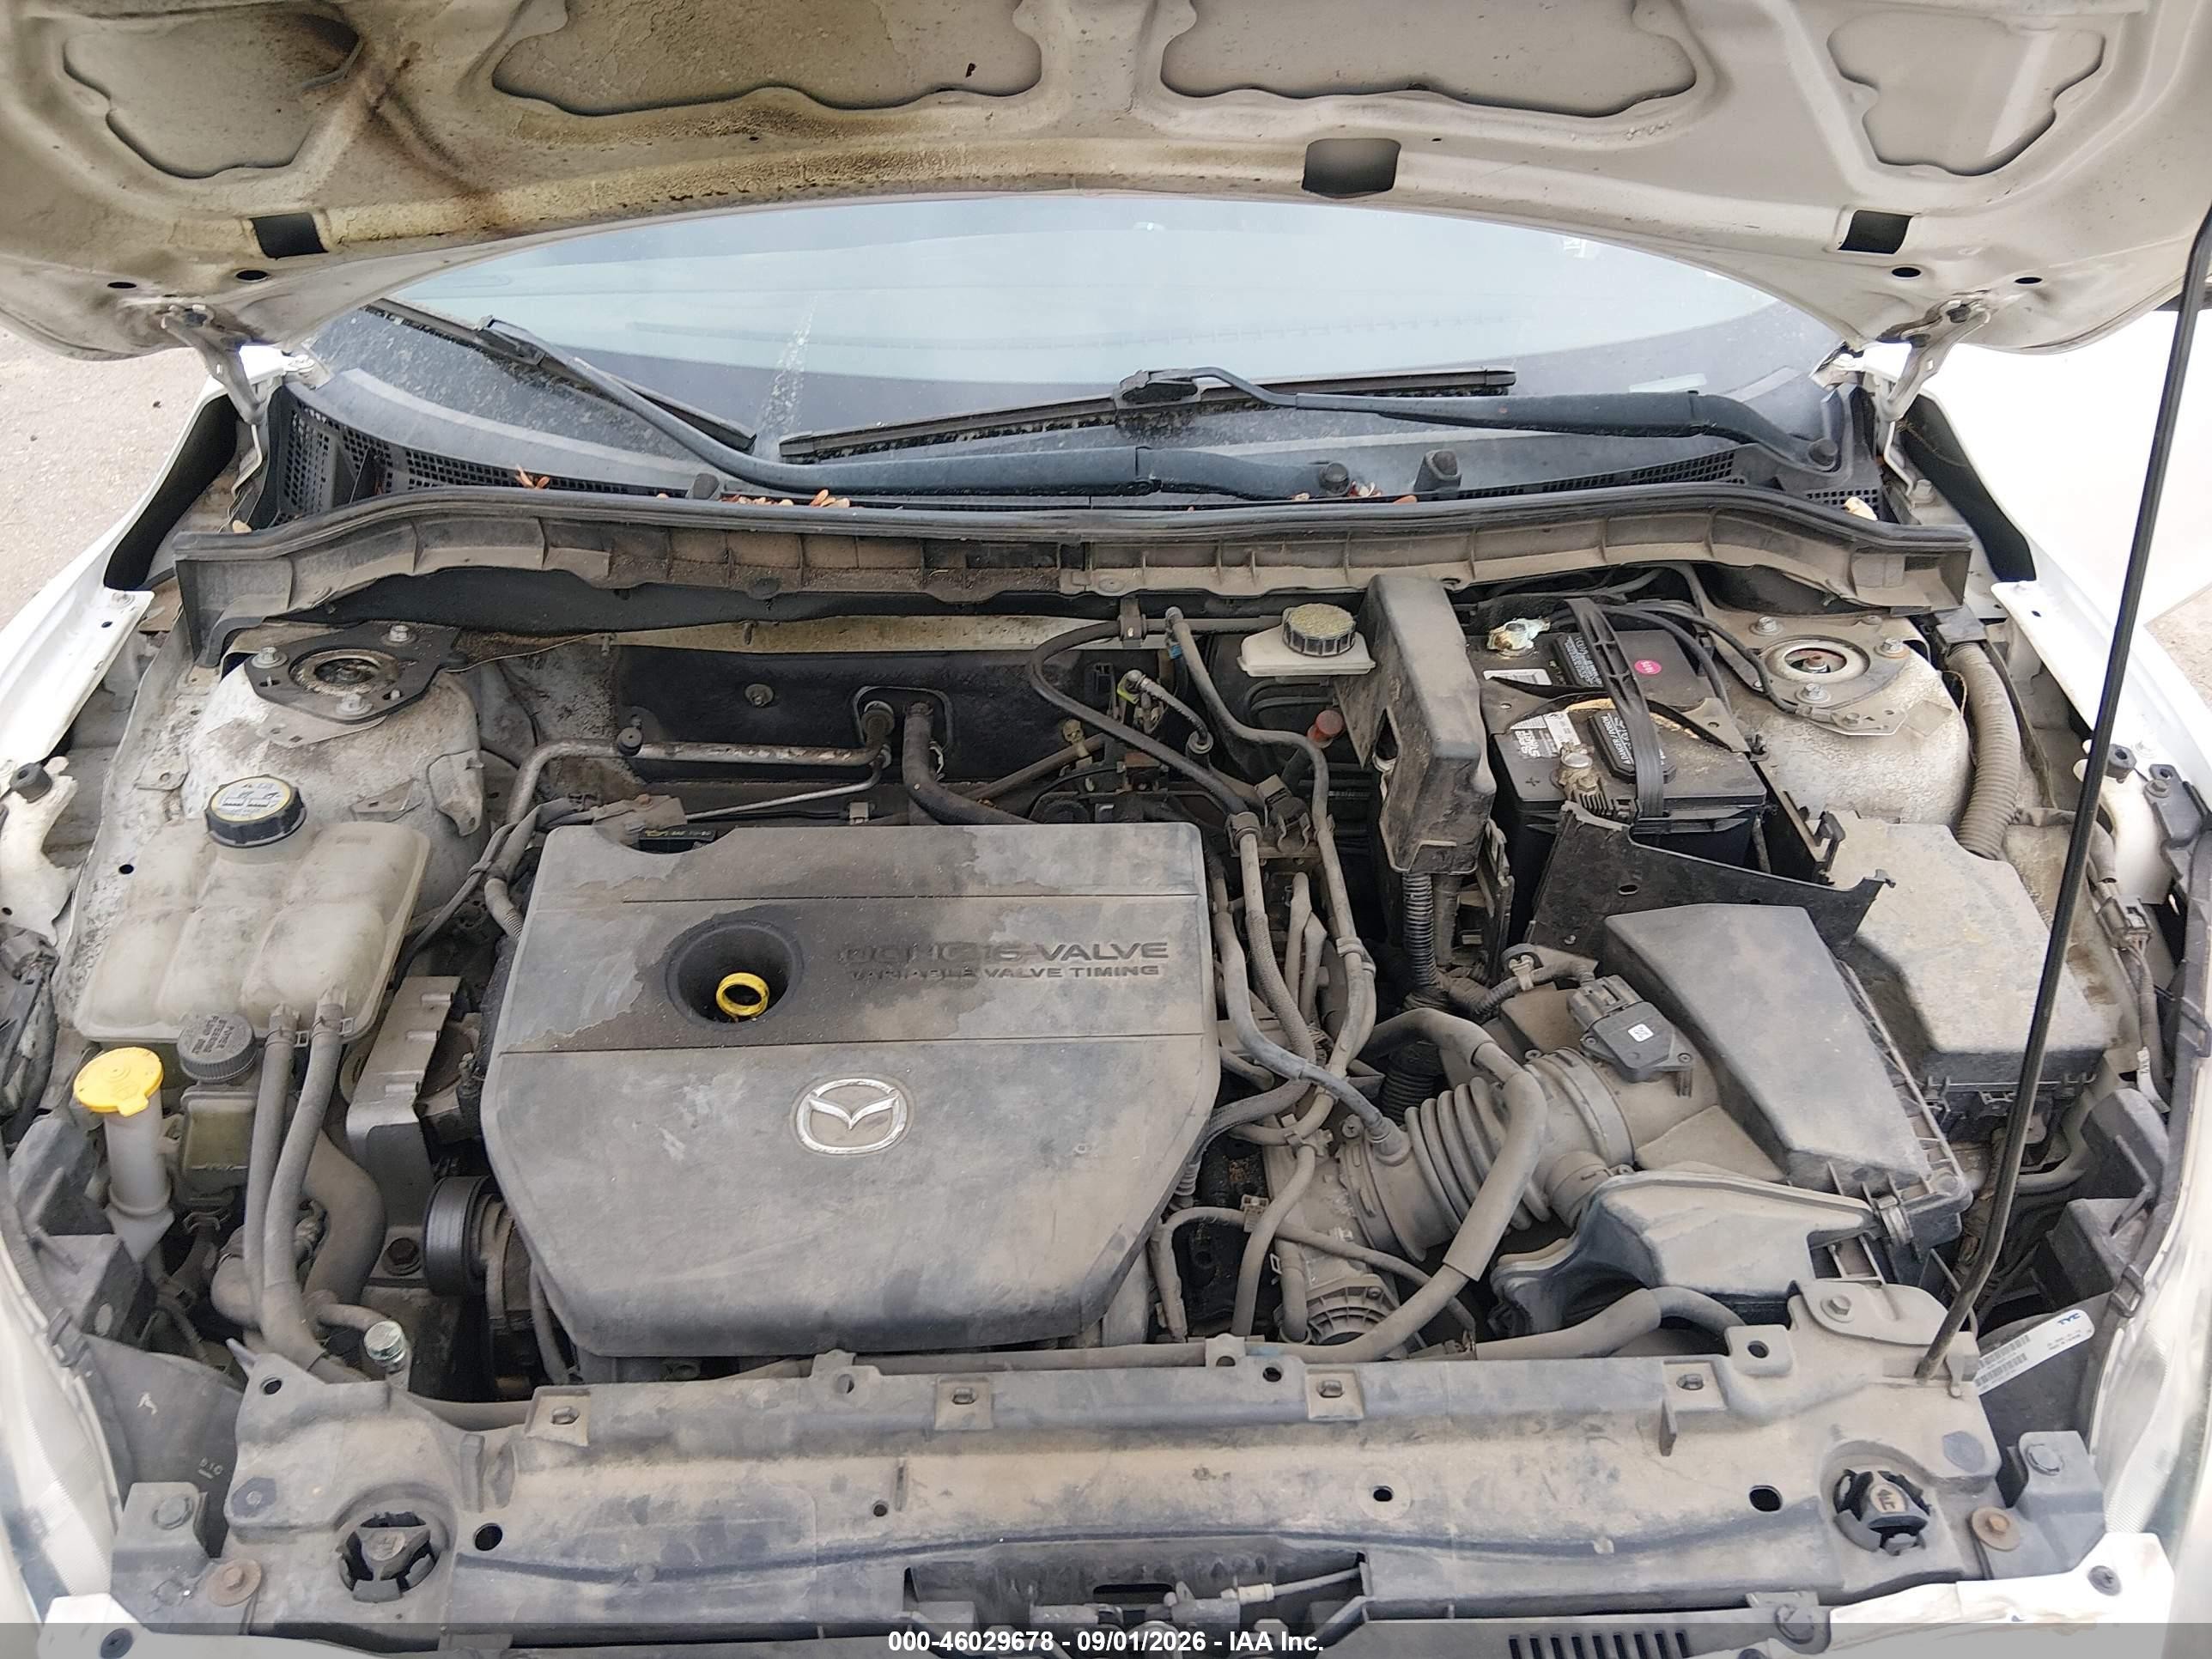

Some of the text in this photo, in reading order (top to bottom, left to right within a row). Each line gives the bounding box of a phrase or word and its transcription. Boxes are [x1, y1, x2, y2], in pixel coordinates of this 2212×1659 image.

[983, 942, 1169, 962] 16-VALVE
[852, 965, 1159, 980] VARIABLE VALVE TIMING
[2057, 1313, 2081, 1325] TYC
